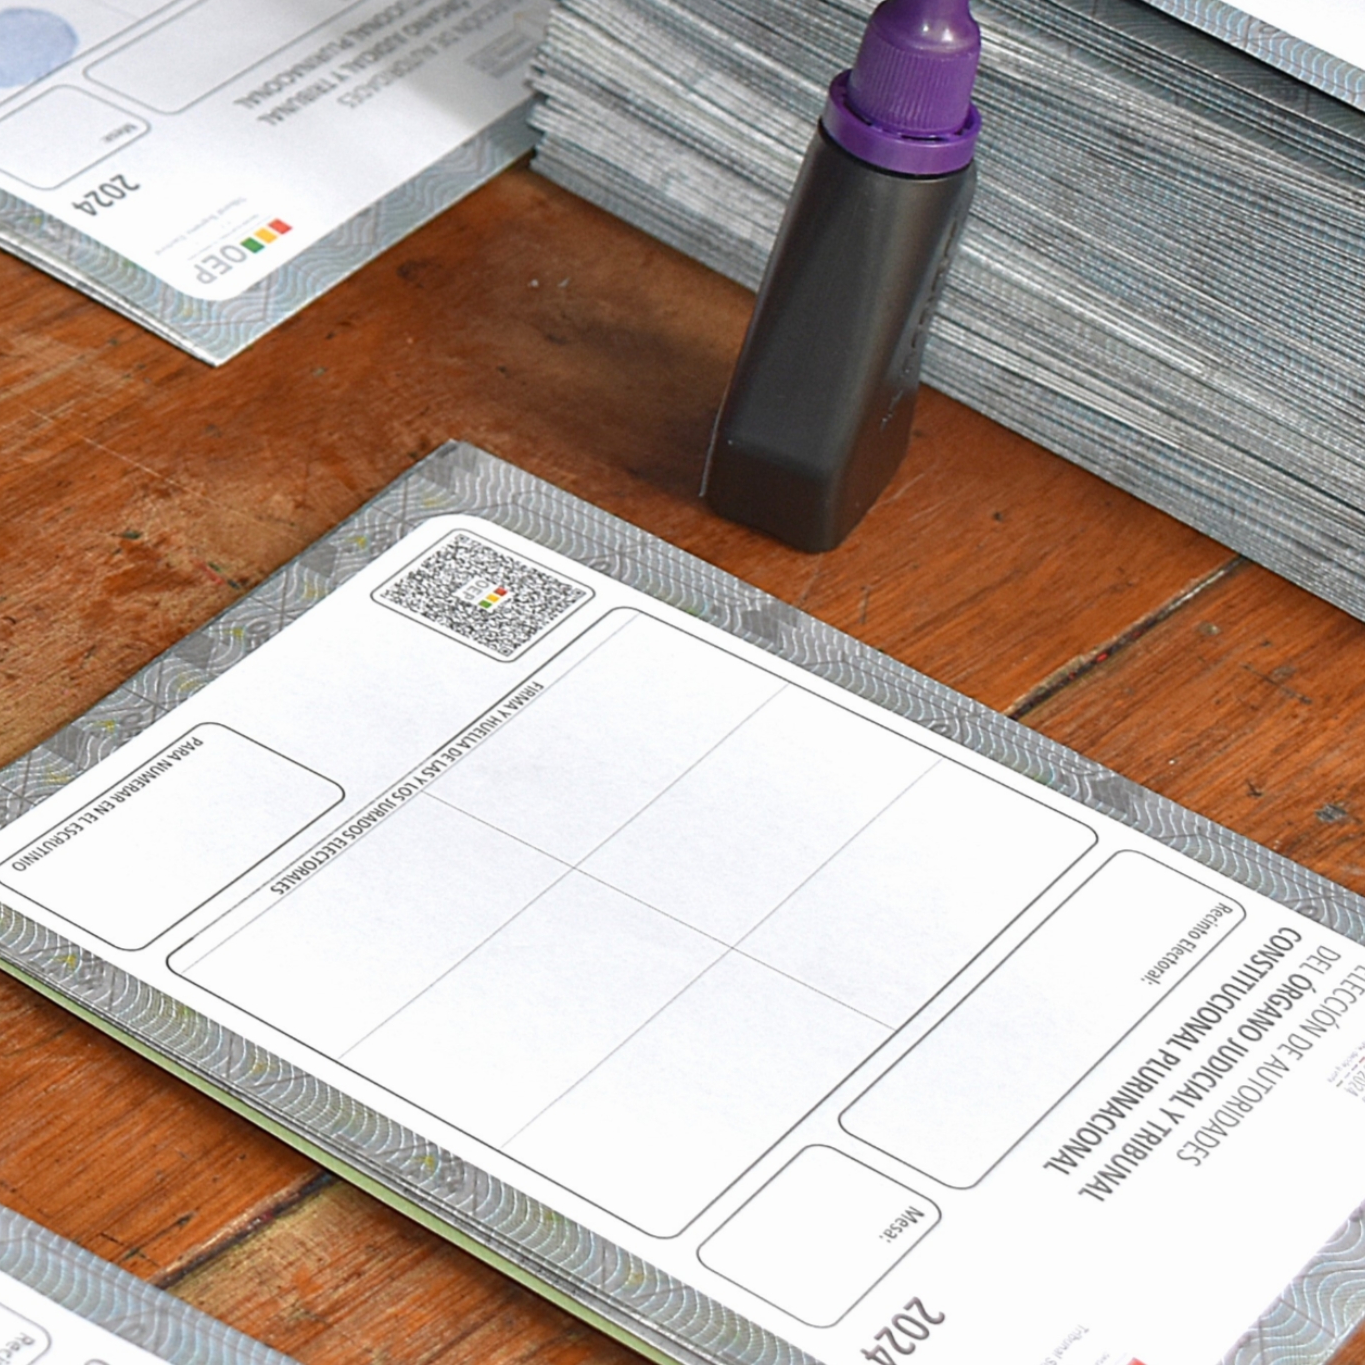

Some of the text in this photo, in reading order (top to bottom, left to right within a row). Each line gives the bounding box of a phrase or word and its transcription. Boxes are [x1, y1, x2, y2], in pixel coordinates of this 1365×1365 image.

[72, 174, 140, 216] 2024
[194, 244, 248, 284] OEP
[11, 736, 204, 872] PARA NUMERAR EN EL ESCRUTINIO
[270, 681, 544, 895] FIRMA Y HUELLA DE LAS Y LOS JURADOS ELECTORALES
[1141, 902, 1233, 985] Recinto Electoral:
[1299, 965, 1365, 1038] LECCIÓN
[1043, 927, 1302, 1175] CONSTITUCIONAL PLURINACIONAL
[1078, 945, 1342, 1202] DEL ÓRGANO JUDICIAL Y TRIBUNAL
[1277, 1033, 1314, 1061] DE
[1176, 1054, 1290, 1167] AUTORIDADES
[879, 1206, 925, 1243] Mesa:
[860, 1297, 946, 1365] 2024
